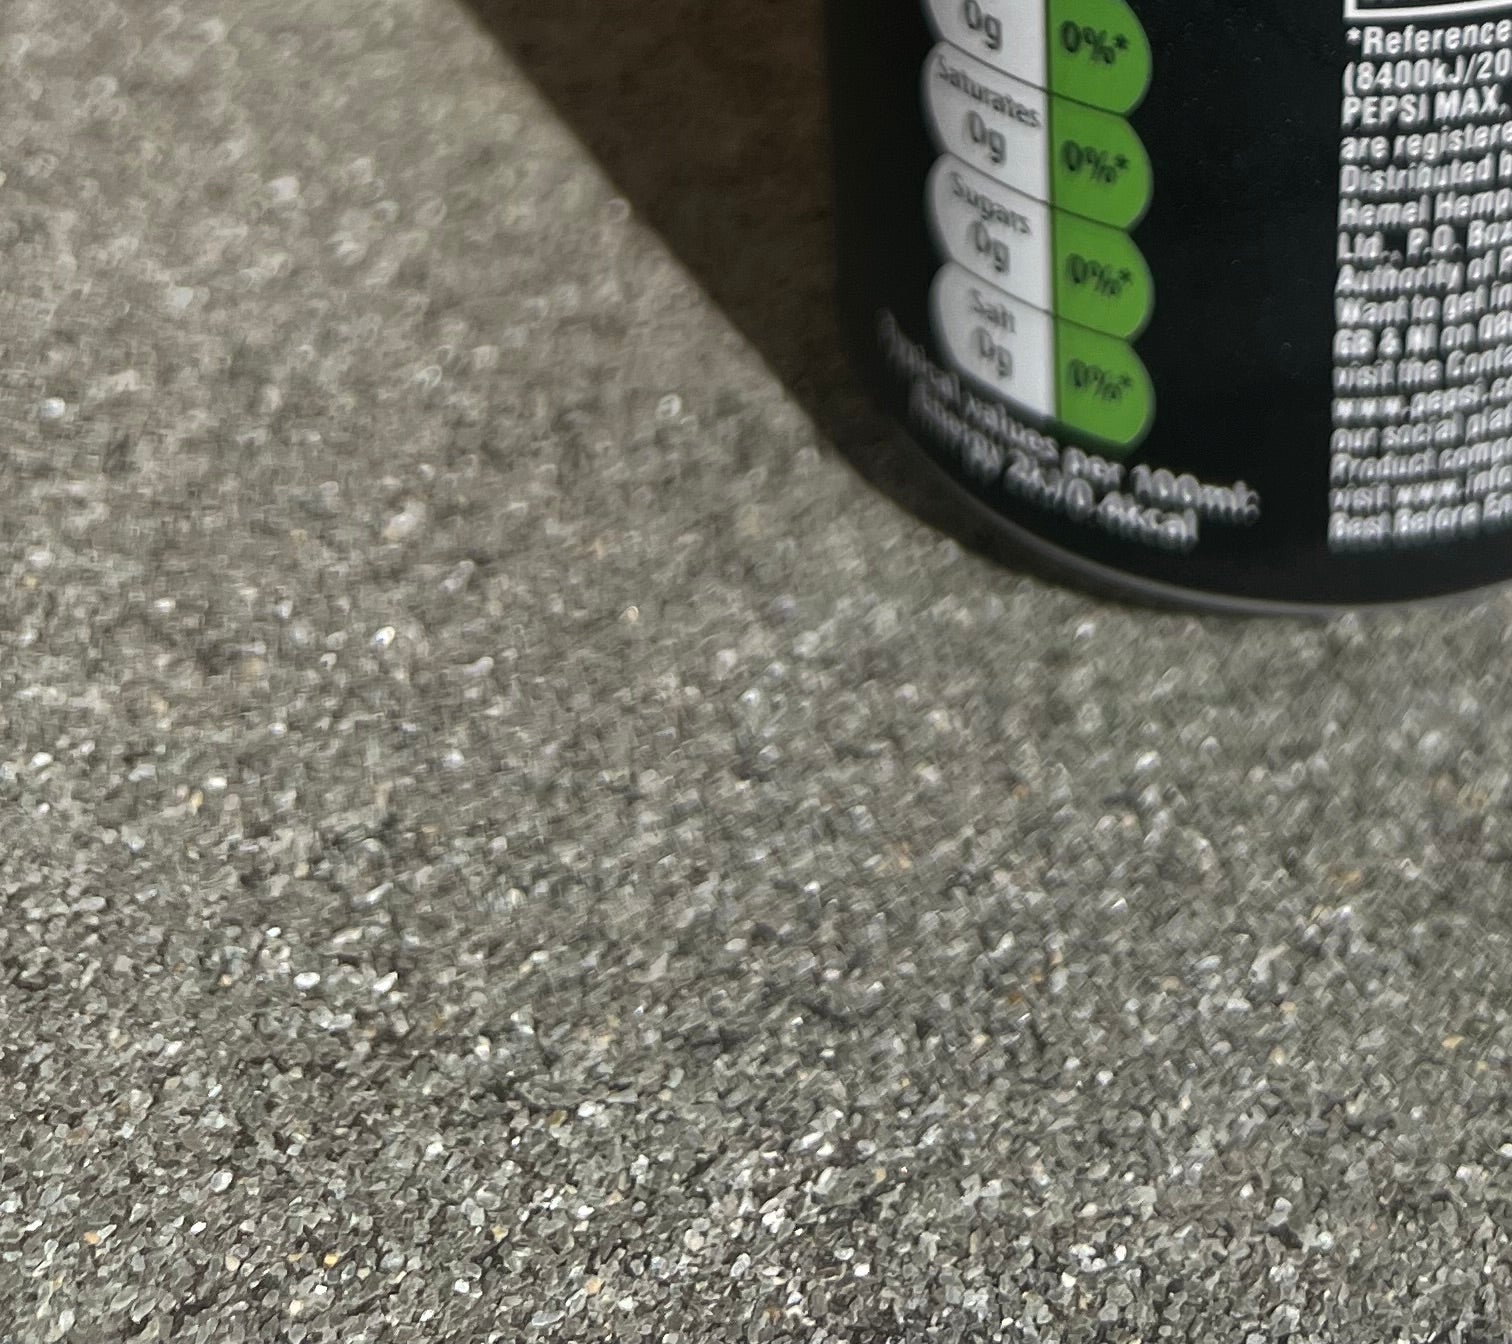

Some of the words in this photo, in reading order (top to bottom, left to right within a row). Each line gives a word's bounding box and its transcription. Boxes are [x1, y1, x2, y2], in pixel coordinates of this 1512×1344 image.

[1341, 93, 1429, 126] PEPSI
[1433, 83, 1511, 122] MAX,
[1340, 136, 1390, 163] are
[1340, 152, 1497, 195] Distributed
[1339, 193, 1432, 229] Hemel
